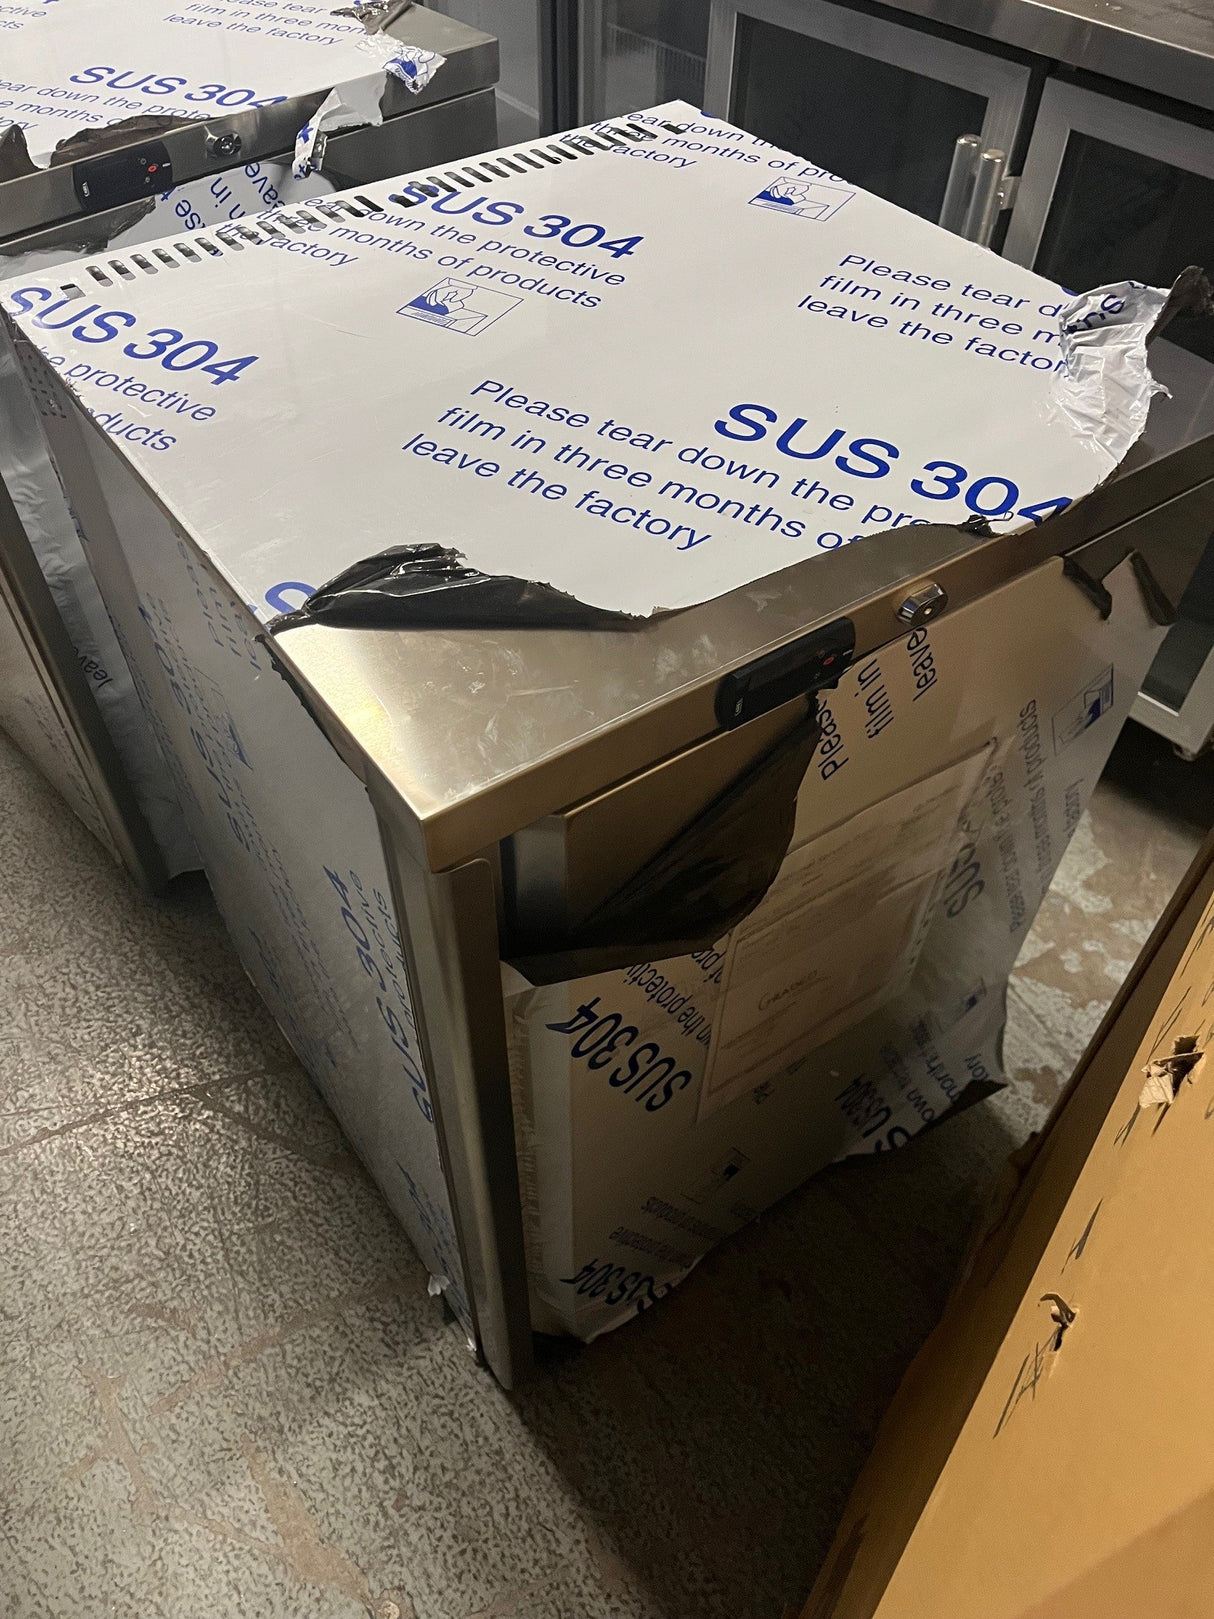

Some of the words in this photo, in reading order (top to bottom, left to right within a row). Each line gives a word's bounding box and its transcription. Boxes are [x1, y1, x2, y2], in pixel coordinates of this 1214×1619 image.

[163, 13, 223, 28] leave
[226, 22, 262, 33] the
[265, 28, 344, 46] factory
[184, 3, 226, 16] film
[230, 9, 251, 18] in
[254, 13, 313, 27] three
[0, 79, 37, 93] ear
[37, 87, 104, 103] down
[103, 97, 143, 110] the
[69, 66, 187, 95] SUS
[15, 103, 104, 126] months
[661, 138, 761, 164] months
[768, 160, 799, 174] of
[388, 184, 524, 226] SUS
[523, 215, 644, 258] 304
[329, 227, 433, 260] months
[437, 255, 474, 270] of
[465, 264, 602, 309] products
[430, 224, 477, 244] the
[476, 239, 626, 286] protective
[838, 254, 951, 292] Please
[961, 284, 1031, 310] tear
[8, 286, 137, 344] SUS
[122, 328, 260, 387] 304
[797, 294, 889, 329] leave
[899, 320, 953, 346] the
[964, 336, 1069, 373] factor
[819, 275, 882, 301] film
[889, 292, 920, 311] in
[931, 304, 1023, 335] three
[66, 361, 217, 422] protective
[437, 406, 506, 441] film
[510, 429, 546, 455] in
[552, 443, 653, 488] three
[657, 479, 807, 538] months
[470, 379, 590, 428] Please
[596, 418, 673, 453] tear
[677, 446, 780, 489] down
[790, 477, 855, 511] the
[713, 403, 900, 479] SUS
[401, 432, 501, 478] leave
[506, 468, 568, 501] the
[574, 489, 712, 551] factory
[853, 658, 882, 698] in
[906, 626, 938, 702] leave
[864, 684, 895, 739] film
[320, 863, 387, 991] 304
[544, 995, 640, 1067] 304
[607, 1042, 693, 1110] SUS
